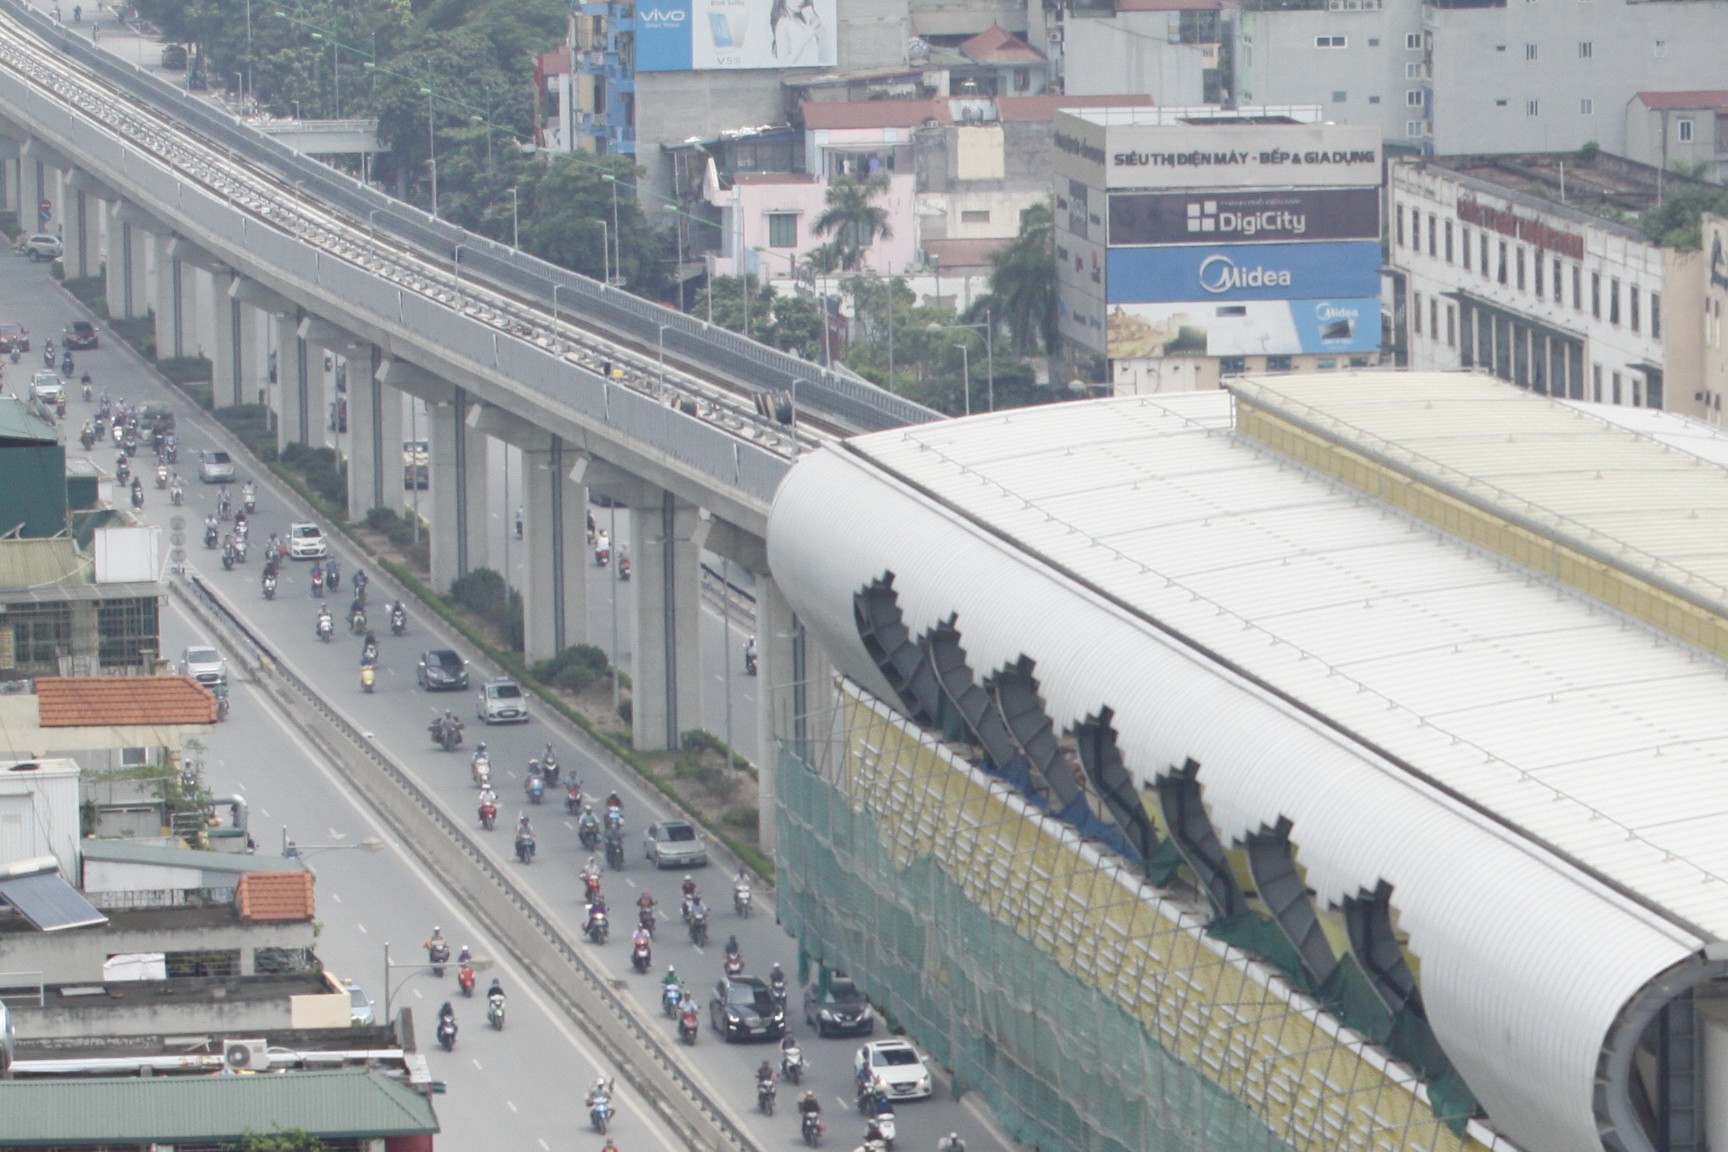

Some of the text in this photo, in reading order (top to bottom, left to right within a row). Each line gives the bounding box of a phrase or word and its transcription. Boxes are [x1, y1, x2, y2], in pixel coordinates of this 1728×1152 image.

[640, 8, 686, 22] vivo
[1114, 149, 1149, 166] SIÊU
[1151, 153, 1175, 169] THỊ
[1176, 150, 1212, 168] ĐIỆN
[1213, 149, 1249, 165] MÁY
[1260, 148, 1290, 164] BẾP
[1291, 153, 1302, 164] &
[1304, 152, 1332, 164] GIA
[1332, 150, 1375, 166] DỤNG
[1219, 211, 1306, 233] DigiCity
[1203, 258, 1291, 290] Midea
[1318, 304, 1359, 319] Midea
